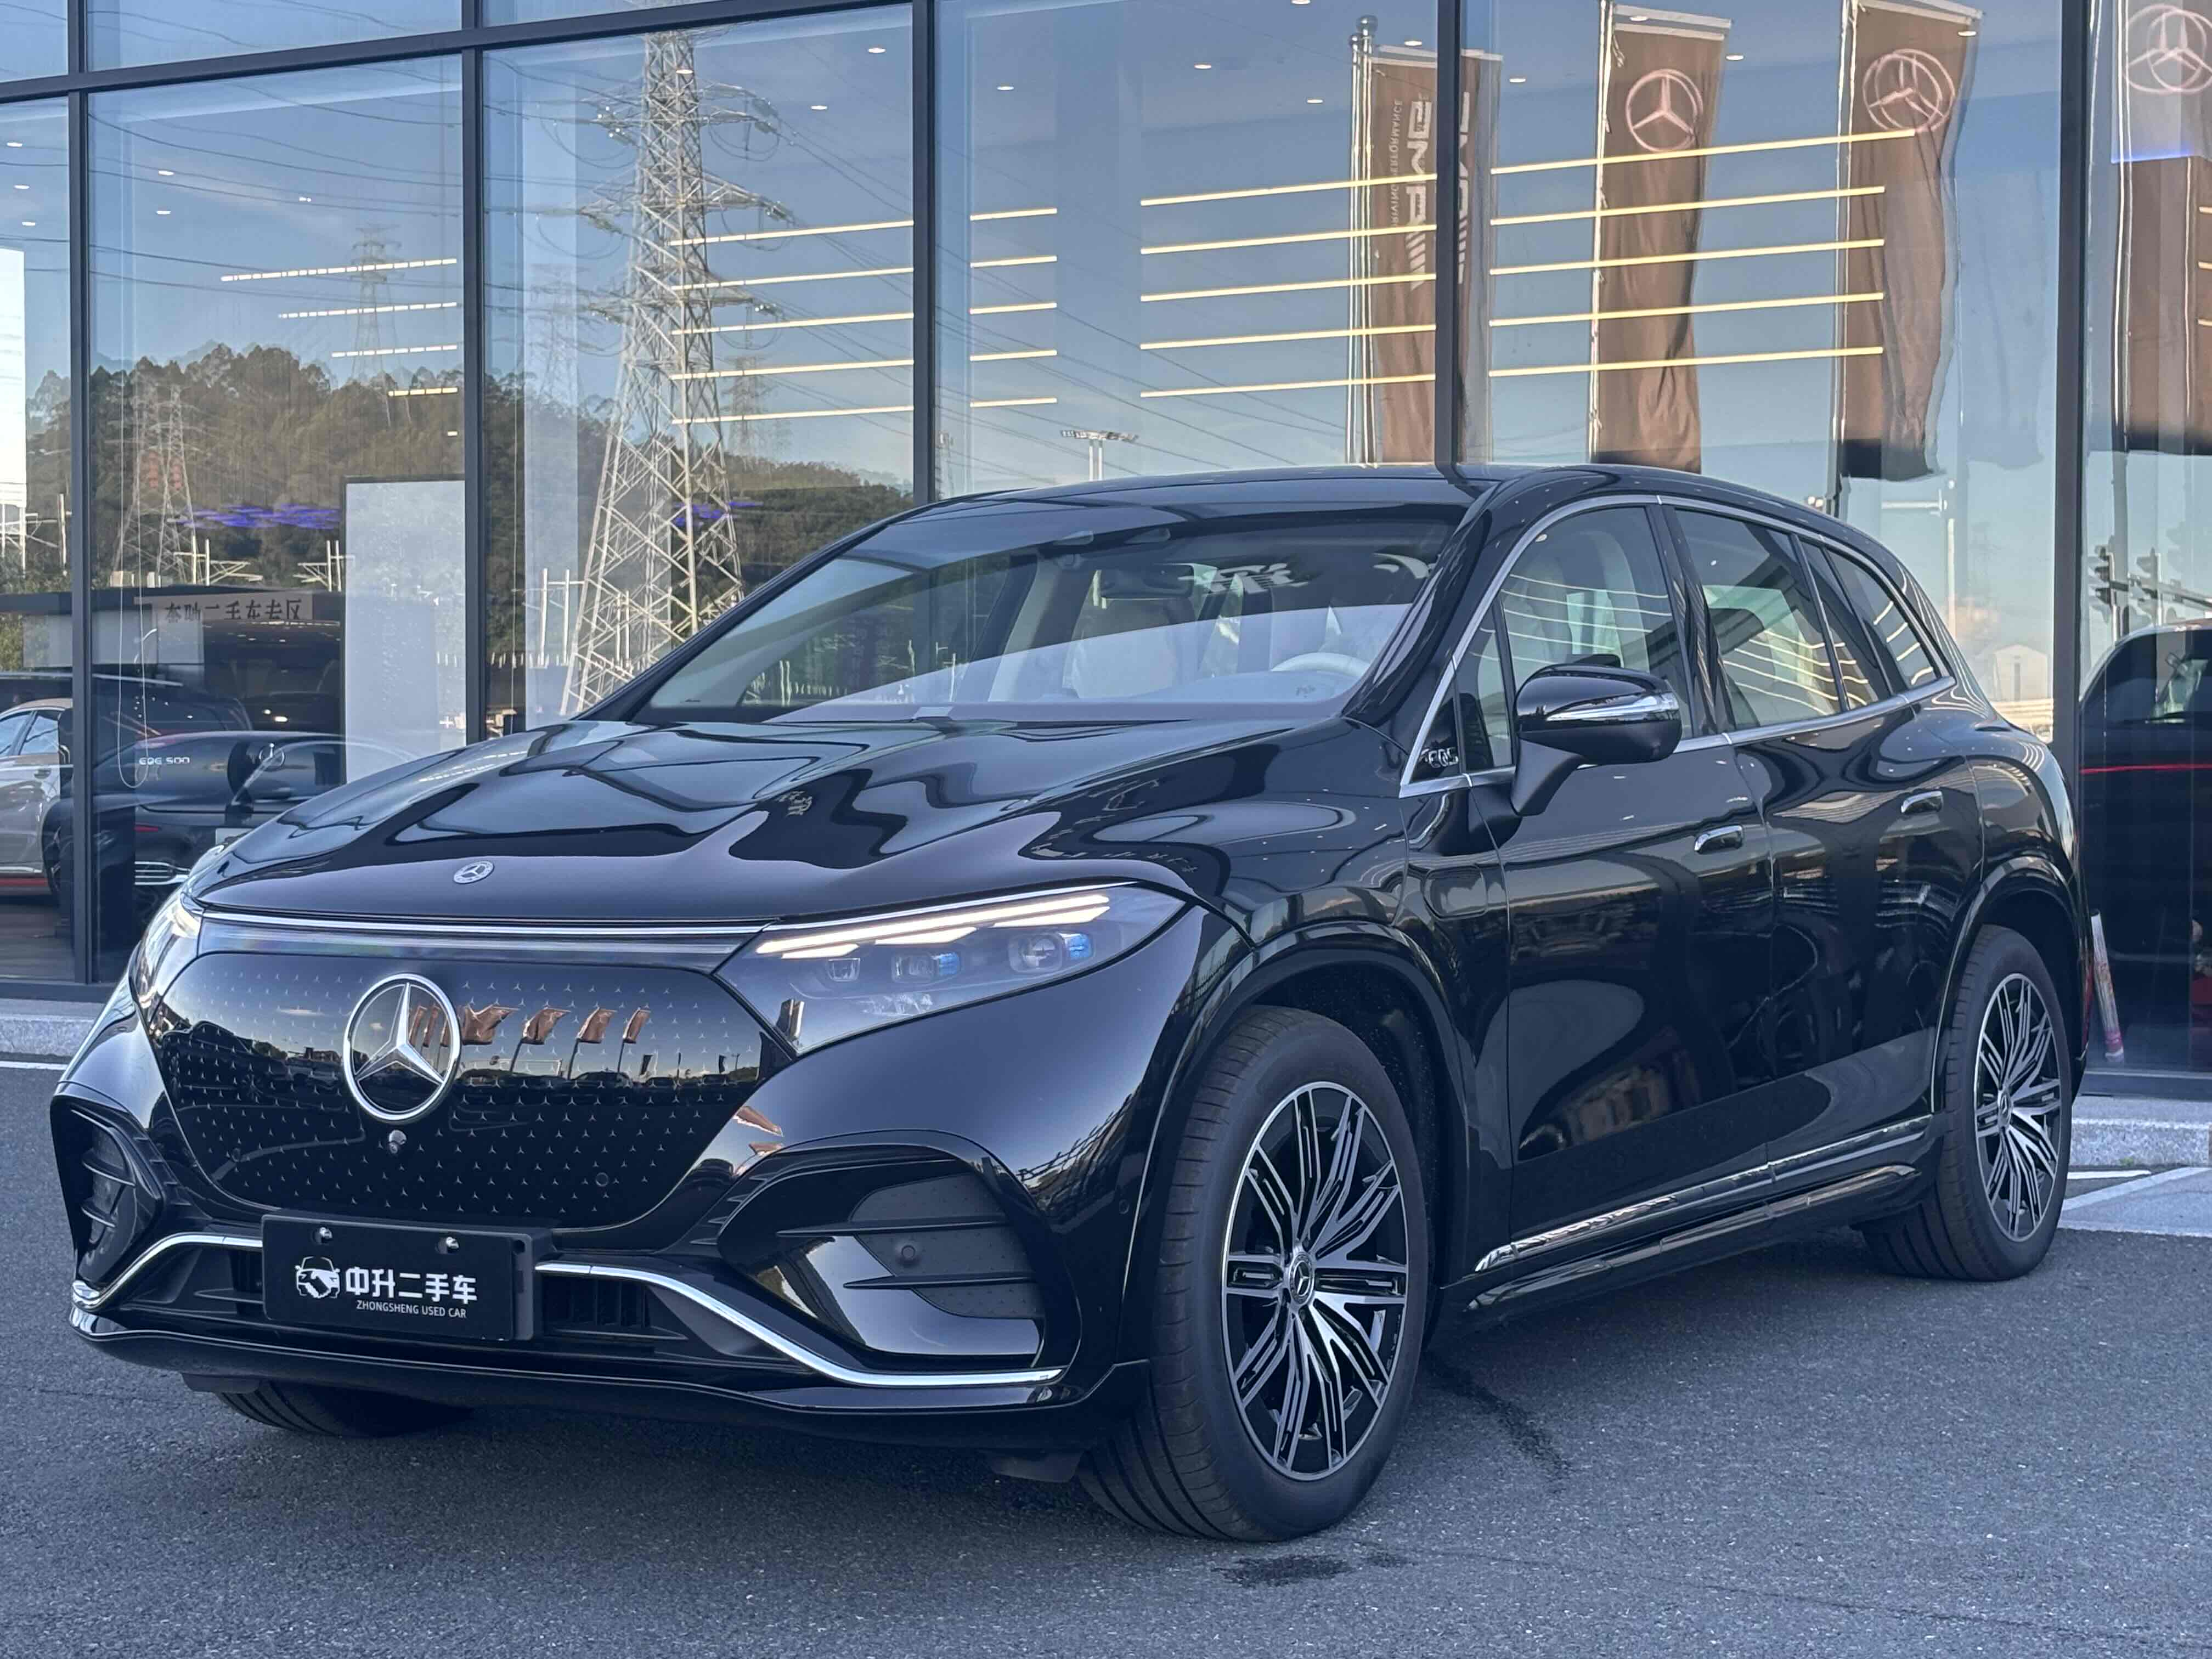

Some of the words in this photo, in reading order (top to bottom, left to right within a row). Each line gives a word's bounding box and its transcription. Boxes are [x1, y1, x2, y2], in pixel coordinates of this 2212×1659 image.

[345, 1266, 478, 1305] 中升二手车
[356, 1299, 419, 1315] ZHONGSHENG
[421, 1306, 446, 1317] USED
[448, 1307, 467, 1318] CAR
